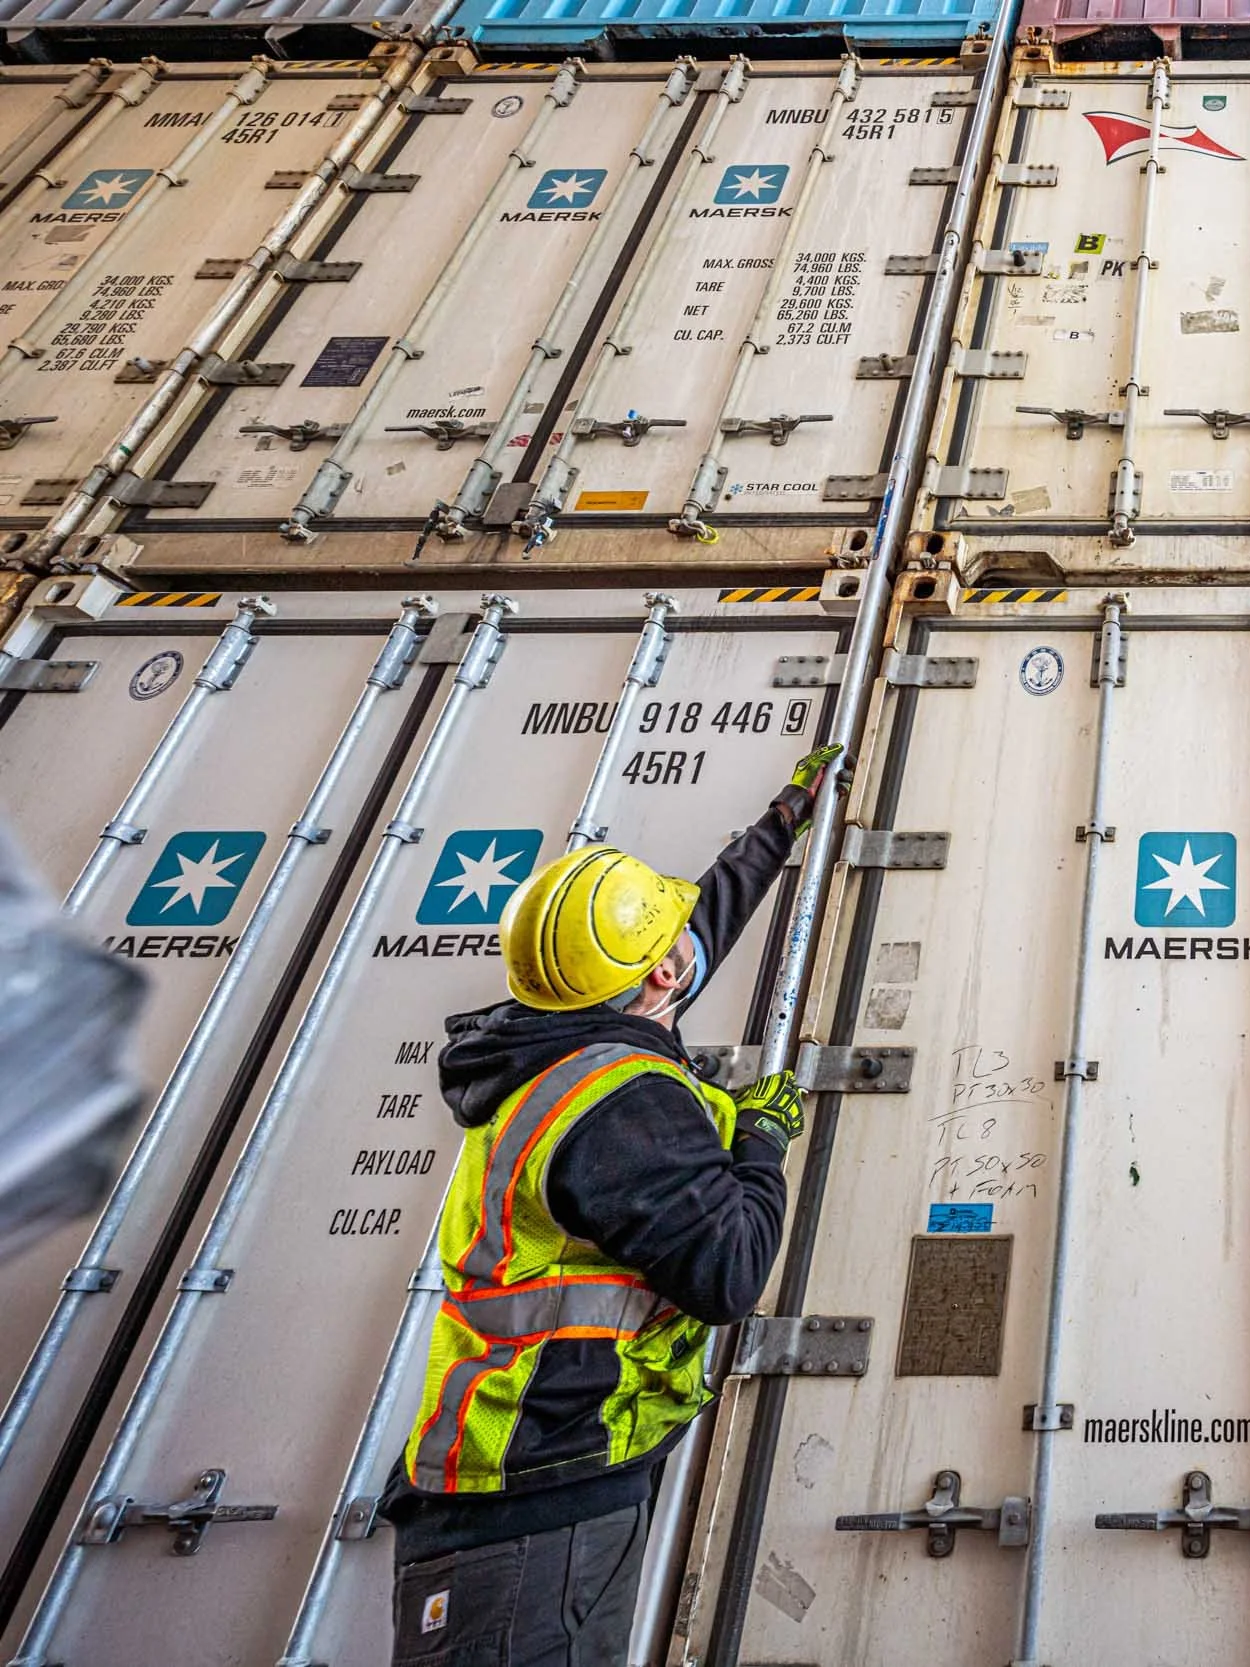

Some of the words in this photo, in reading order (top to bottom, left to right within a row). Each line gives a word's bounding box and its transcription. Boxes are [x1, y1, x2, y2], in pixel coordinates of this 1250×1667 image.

[236, 112, 279, 127] 126
[280, 112, 326, 127] 014
[765, 109, 829, 124] MNBU
[846, 108, 887, 124] 432
[893, 108, 932, 124] 581
[938, 108, 953, 124] 5
[221, 128, 280, 143] 45R1
[842, 125, 896, 140] 45R1
[29, 212, 128, 223] MAERS
[500, 212, 602, 222] MAERSK
[689, 207, 794, 218] MAERSK
[1078, 233, 1100, 250] B
[702, 259, 734, 269] MAX.
[737, 258, 776, 269] GROSS
[795, 253, 836, 263] 34,000
[841, 253, 867, 262] KGS.
[793, 263, 833, 274] 74,960
[837, 263, 862, 273] LBS.
[1101, 260, 1126, 277] PK
[795, 275, 829, 286] 4,400
[834, 275, 861, 285] KGS.
[695, 281, 726, 292] TARE
[792, 286, 826, 297] 9,700
[830, 286, 855, 296] LBS.
[780, 299, 822, 310] 29,600
[827, 299, 854, 309] KGS.
[683, 305, 710, 316] NET
[776, 310, 818, 321] 65,260
[823, 310, 849, 320] LBS.
[787, 323, 814, 334] 67.2
[820, 323, 852, 333] CU.M
[776, 334, 811, 346] 2,373
[816, 334, 851, 345] CU.FT
[1069, 331, 1080, 339] B
[406, 405, 486, 418] maersk.com
[745, 483, 780, 491] STAR
[783, 483, 819, 491] COOL
[521, 702, 619, 735] MNBU
[639, 702, 703, 734] 918
[711, 702, 773, 734] 446
[783, 701, 809, 735] 9
[622, 751, 706, 785] 45R1
[371, 934, 504, 957] MAERS
[394, 1042, 434, 1065] MAX
[376, 1094, 422, 1119] TARE
[351, 1150, 436, 1176] PAYLOAD
